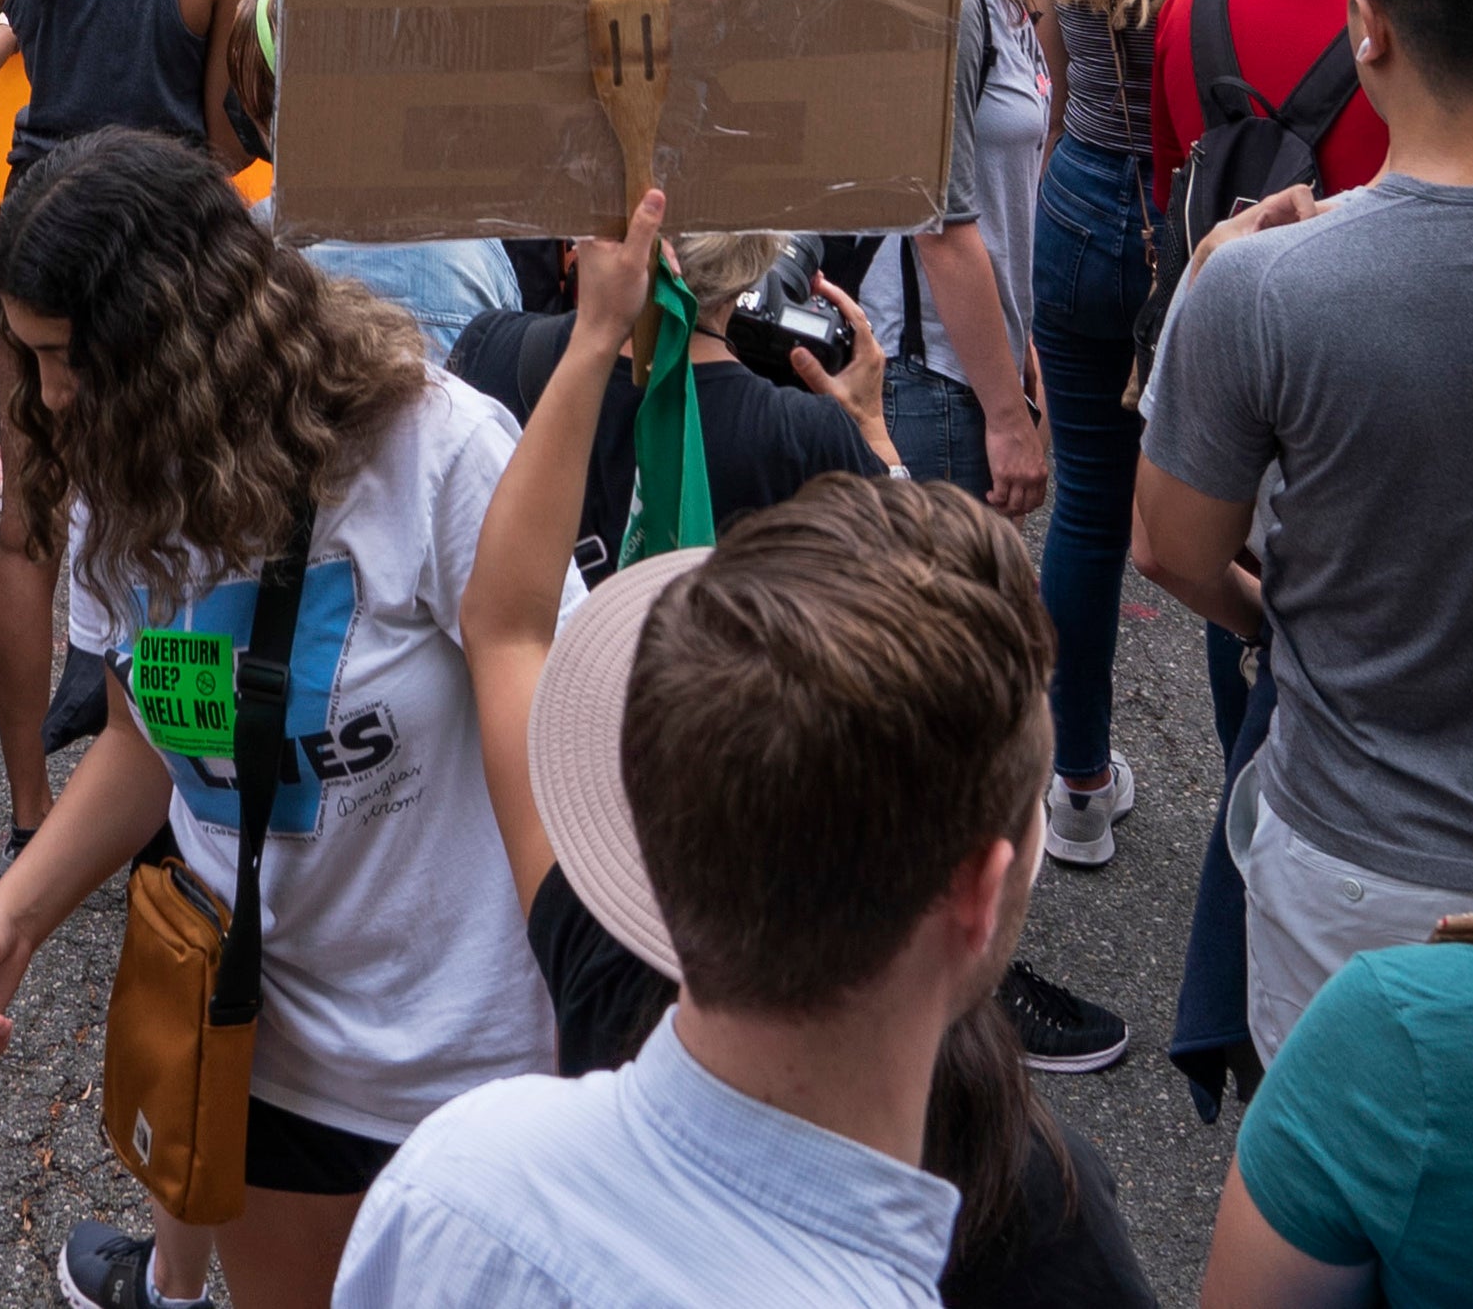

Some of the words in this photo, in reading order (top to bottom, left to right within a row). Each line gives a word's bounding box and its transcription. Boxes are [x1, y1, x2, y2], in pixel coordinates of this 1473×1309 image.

[140, 635, 220, 666] OVERTURN
[140, 664, 181, 692] ROE?
[142, 694, 190, 728] HELL
[194, 700, 229, 731] NO!
[336, 764, 423, 817] Douglas
